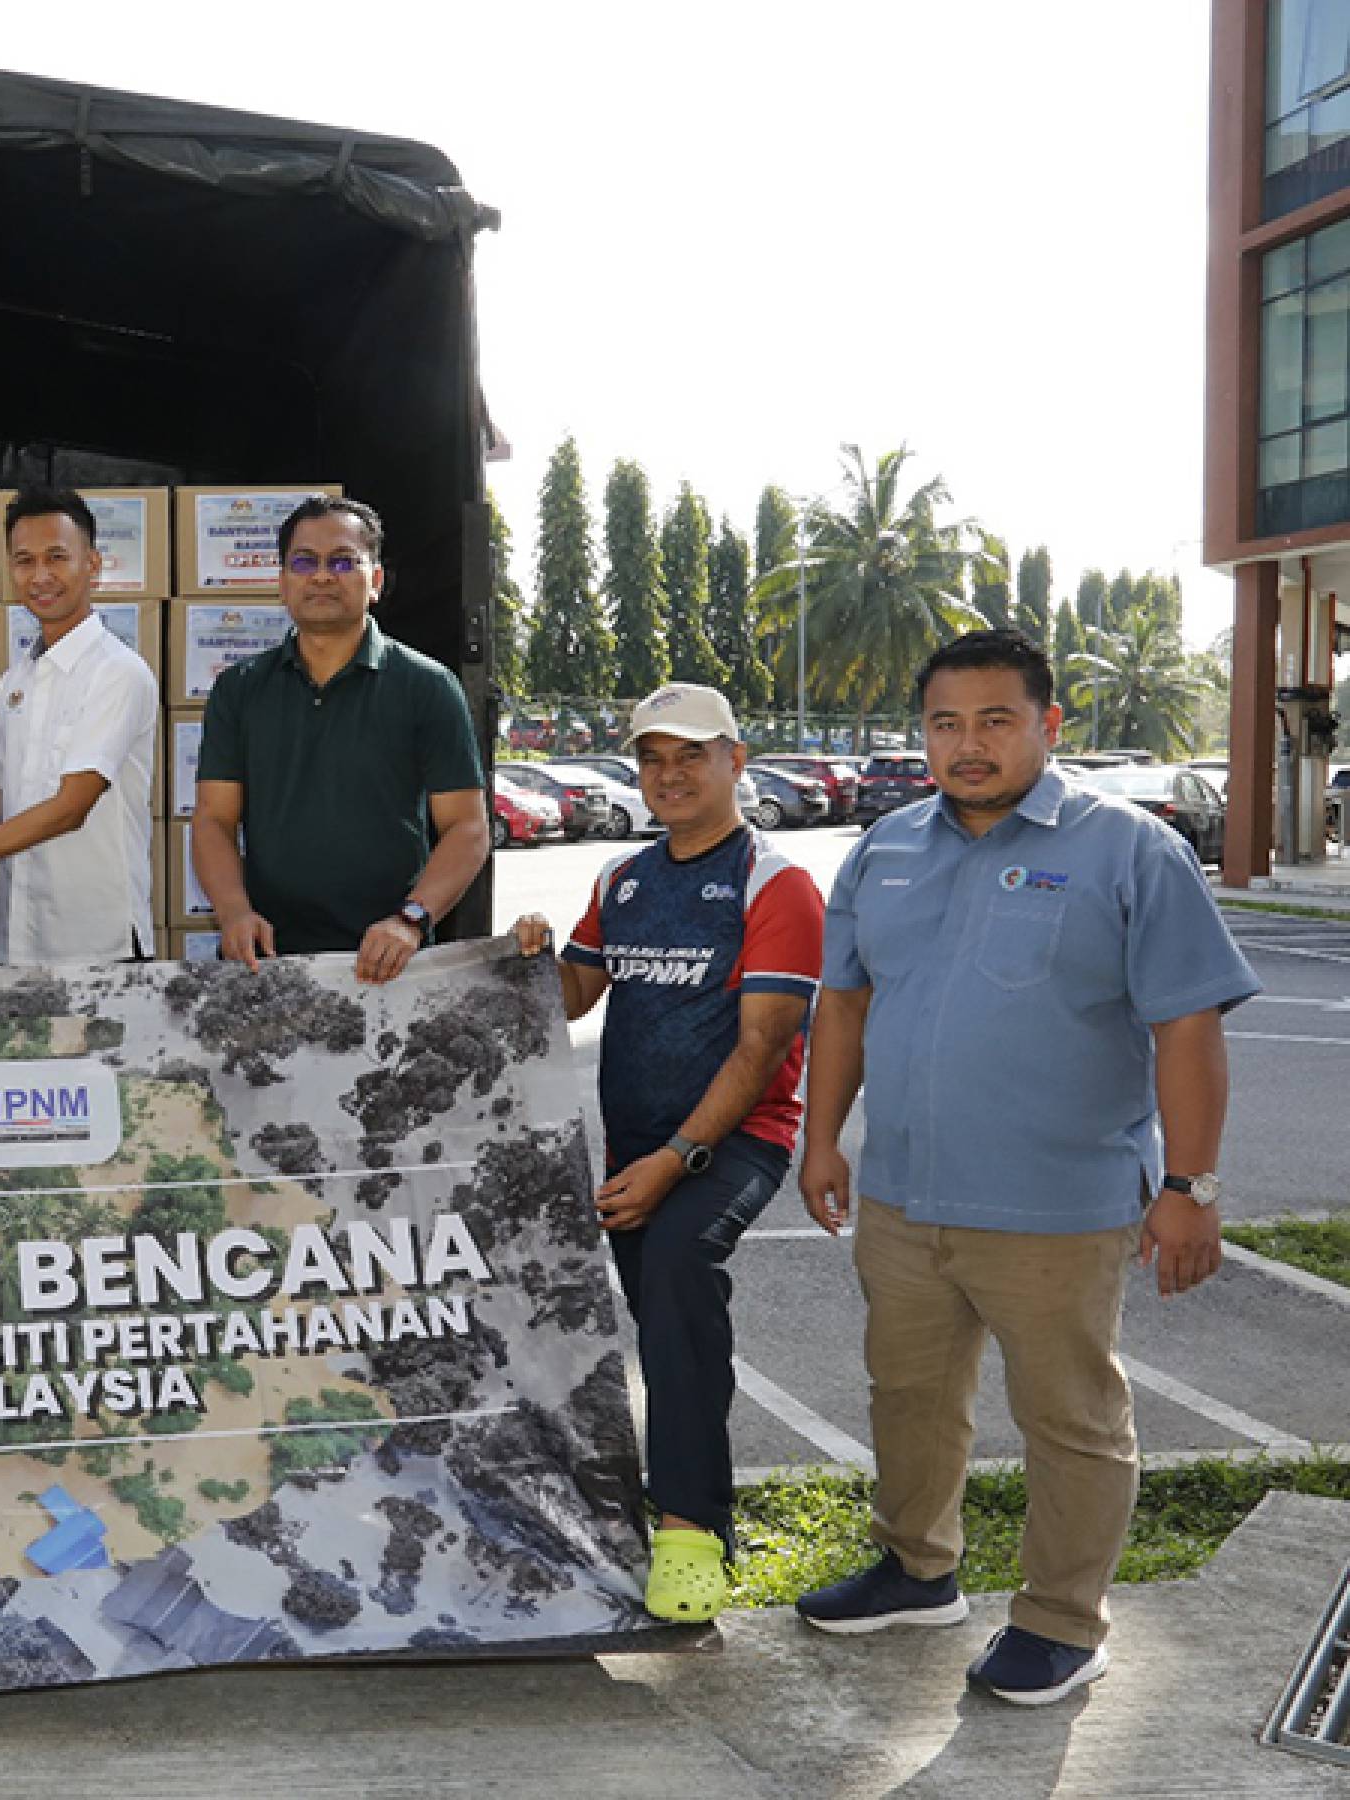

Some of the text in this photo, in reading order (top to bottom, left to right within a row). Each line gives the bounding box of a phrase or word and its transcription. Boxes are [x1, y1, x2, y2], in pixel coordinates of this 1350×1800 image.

[605, 957, 710, 985] UPNM
[19, 1214, 493, 1311] BENCANA
[84, 1296, 474, 1364] PERTAHANAN
